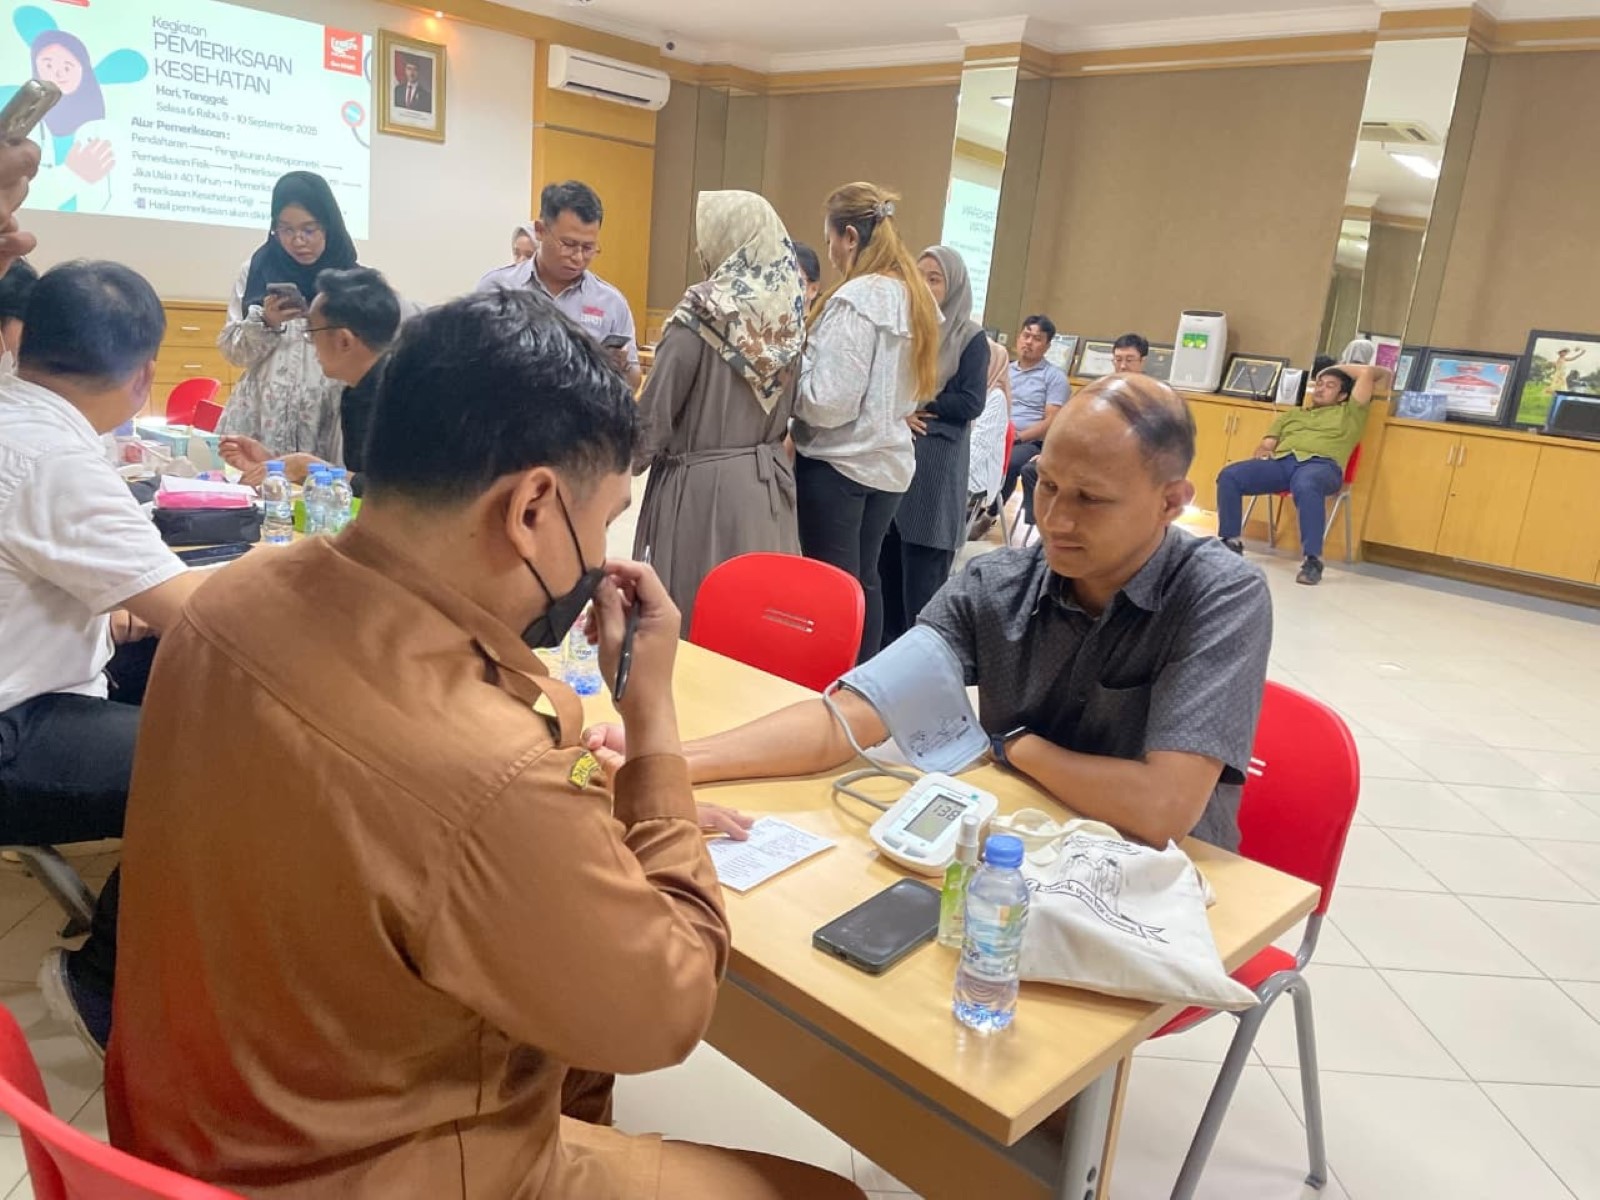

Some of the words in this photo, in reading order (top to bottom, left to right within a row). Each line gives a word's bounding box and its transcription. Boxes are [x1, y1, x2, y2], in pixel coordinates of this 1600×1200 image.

[152, 15, 207, 37] Kegiatan
[154, 31, 293, 75] PEMERIKSAAN
[155, 58, 271, 95] KESEHATAN
[131, 116, 153, 128] Alur
[156, 102, 186, 115] Selasa
[221, 111, 229, 121] 9
[237, 113, 247, 125] 10
[248, 116, 294, 131] September
[296, 124, 318, 136] 2025
[132, 150, 190, 167] Pemeriksaan
[214, 145, 264, 161] Pengukuran
[152, 169, 171, 180] Usia
[180, 173, 193, 183] 40
[196, 173, 222, 187] Tahun
[234, 179, 272, 192] Pemeriks
[133, 183, 190, 198] Pemeriksaan
[192, 189, 236, 202] Kesehatan
[149, 200, 170, 210] Hasil
[172, 202, 227, 216] pemeriksaan
[933, 804, 961, 821] 138
